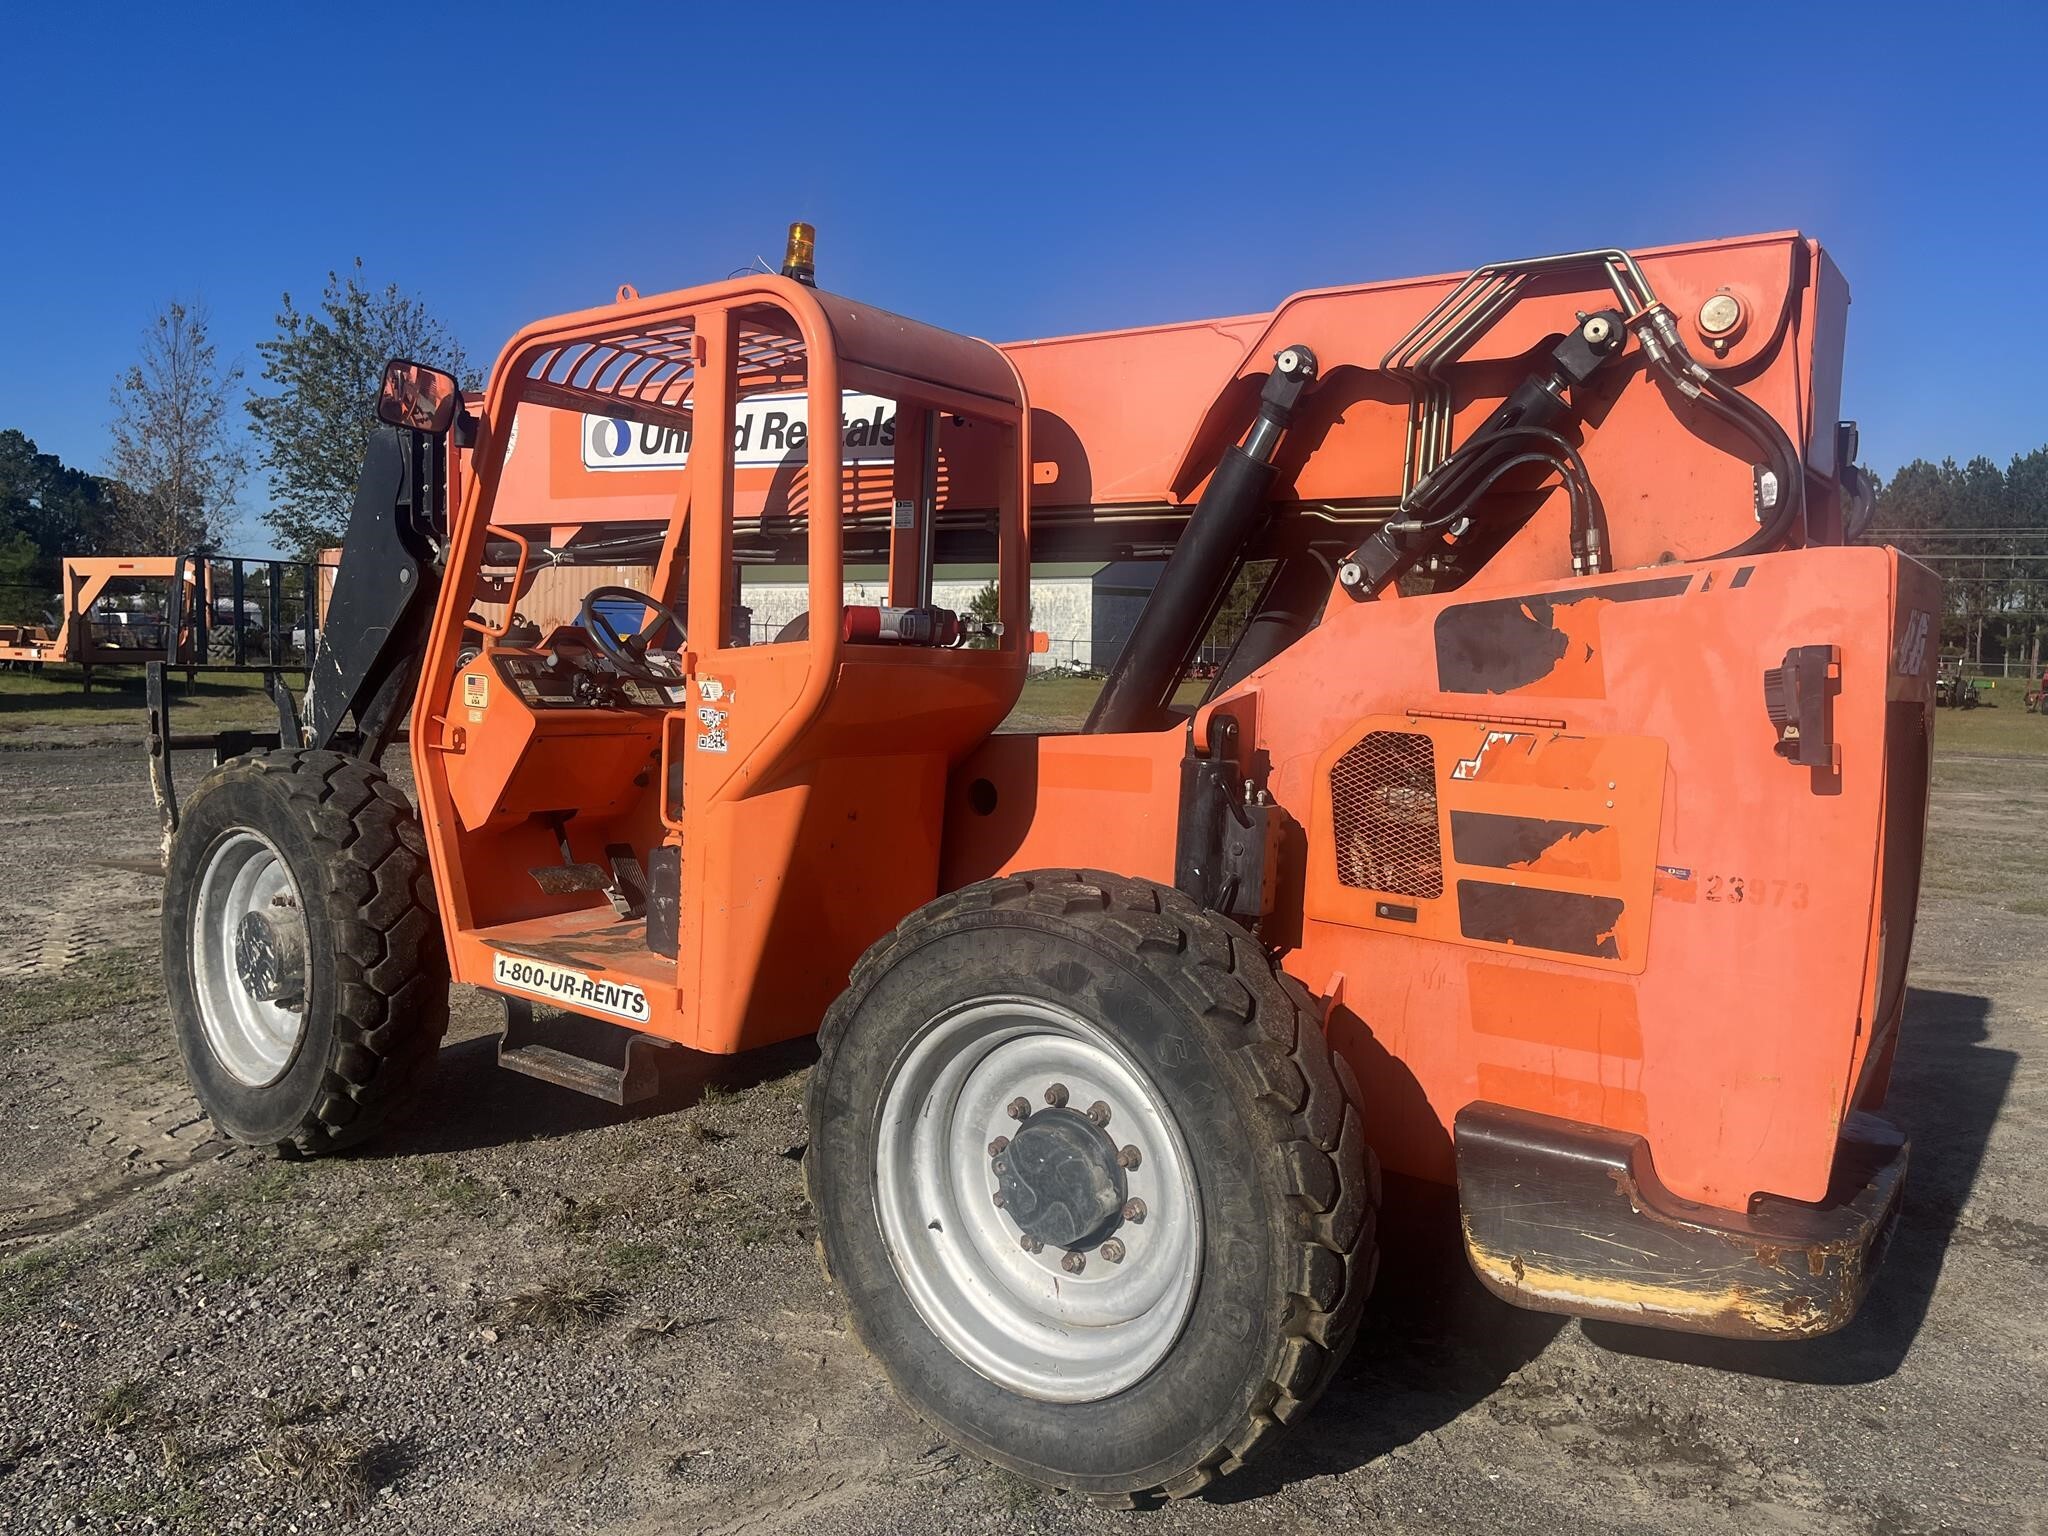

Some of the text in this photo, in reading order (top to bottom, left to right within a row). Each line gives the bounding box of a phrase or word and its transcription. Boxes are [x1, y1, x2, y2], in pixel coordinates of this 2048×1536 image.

[639, 406, 897, 455] Und Reals
[498, 960, 645, 1014] 1-800-UR-RENTS
